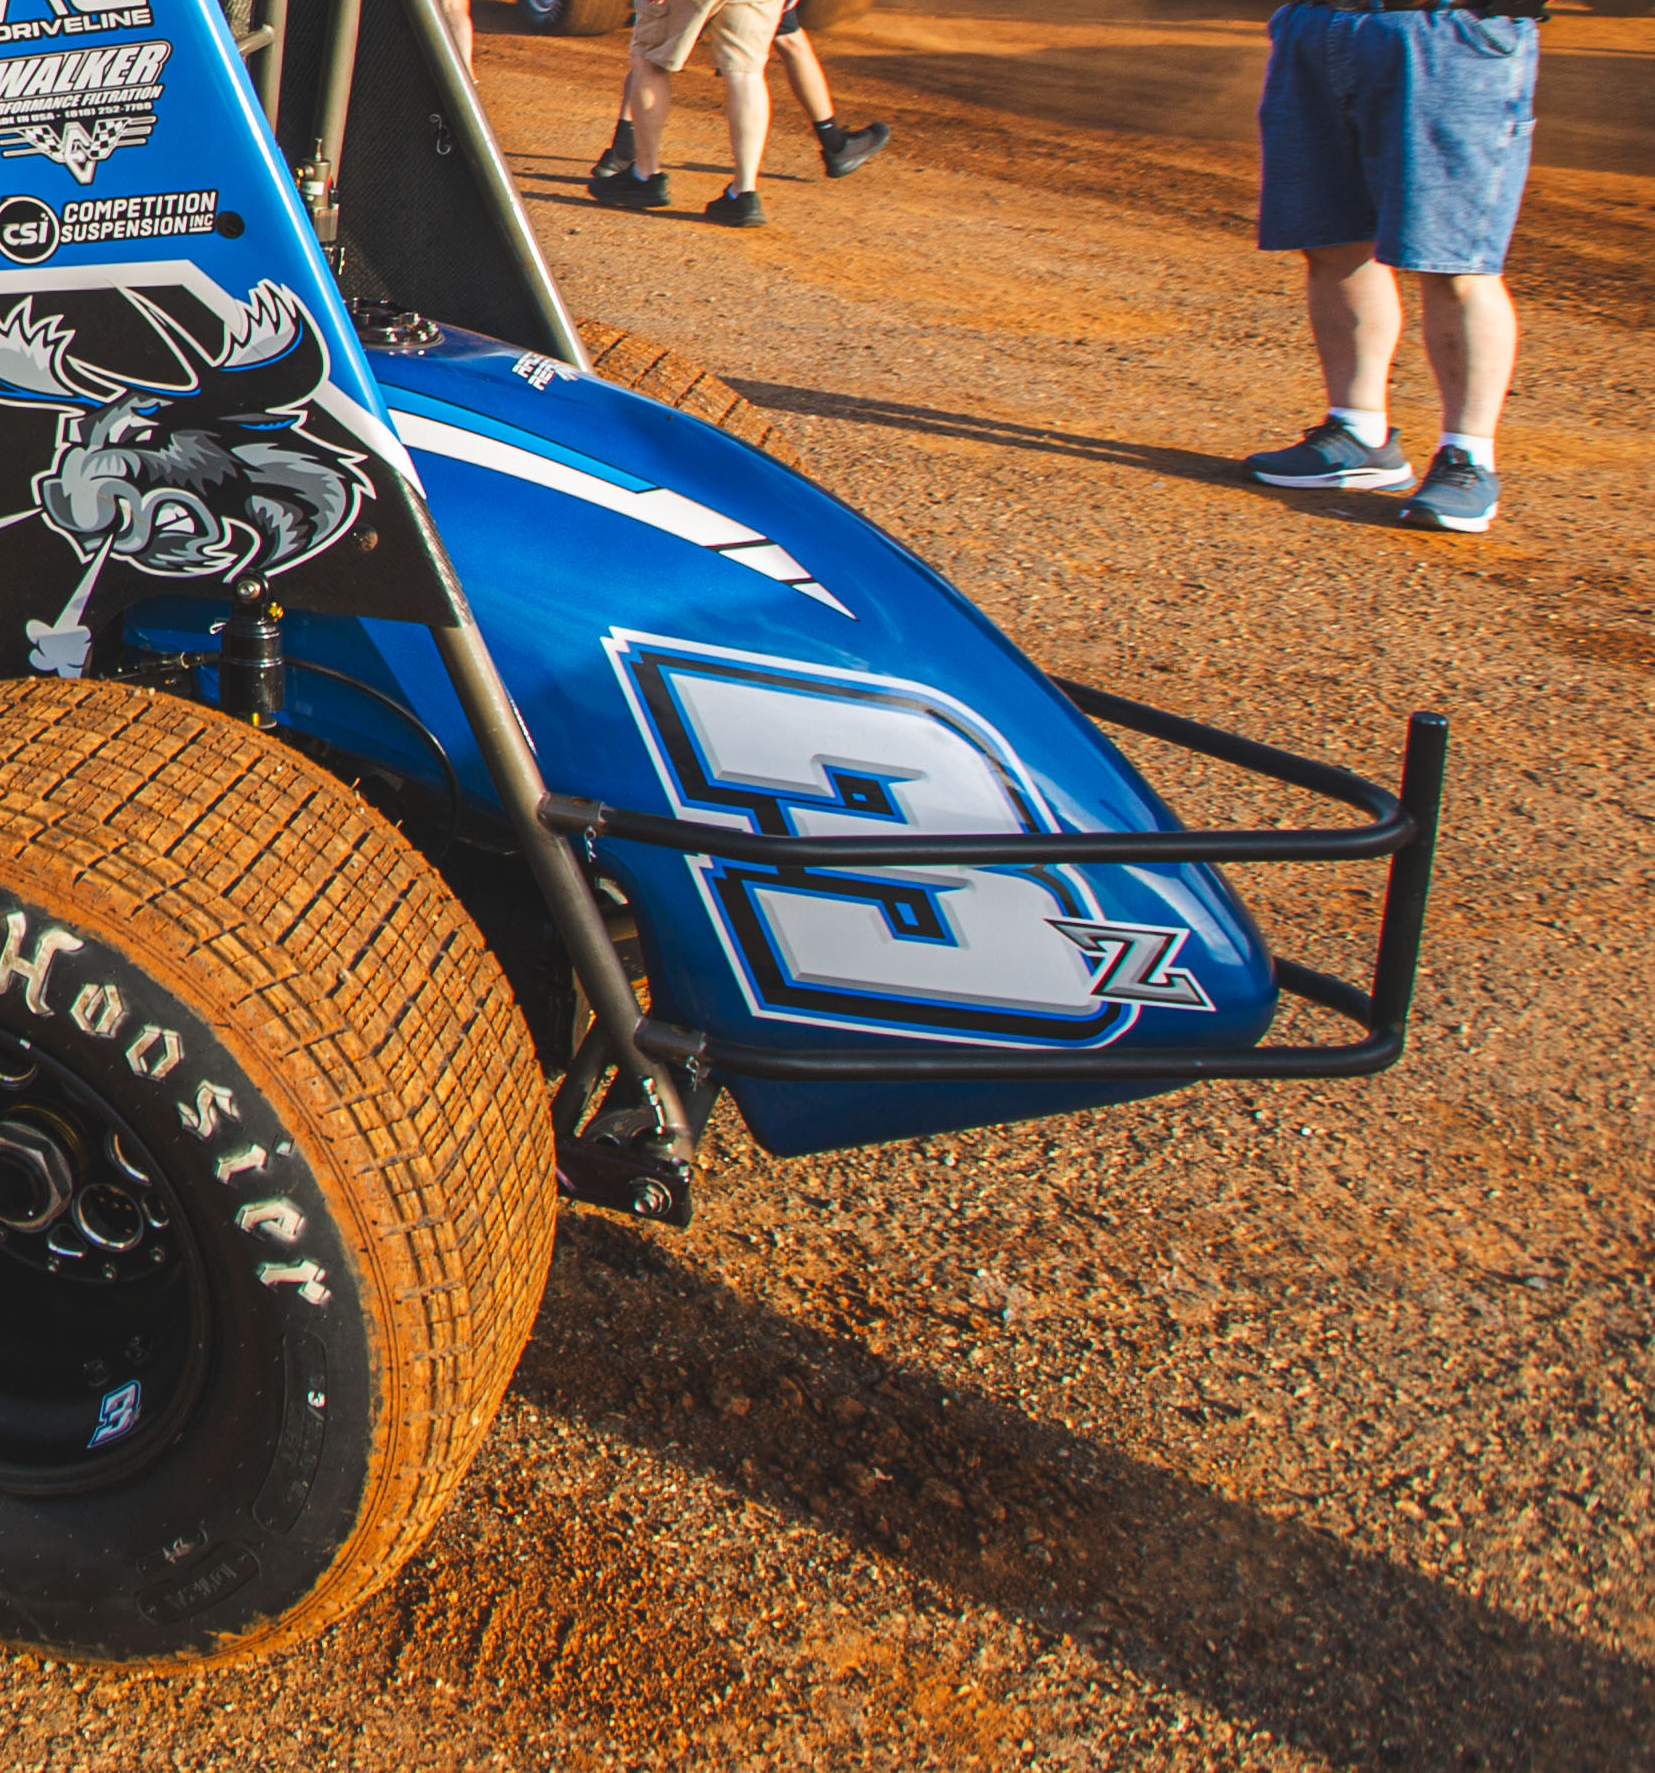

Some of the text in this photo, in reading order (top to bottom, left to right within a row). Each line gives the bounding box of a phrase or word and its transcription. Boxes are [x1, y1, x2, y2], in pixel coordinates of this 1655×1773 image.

[81, 85, 164, 108] FILTRATION
[64, 191, 217, 223] COMPETITION
[61, 213, 214, 244] SUSPENSION INC
[635, 652, 1125, 1039] 3
